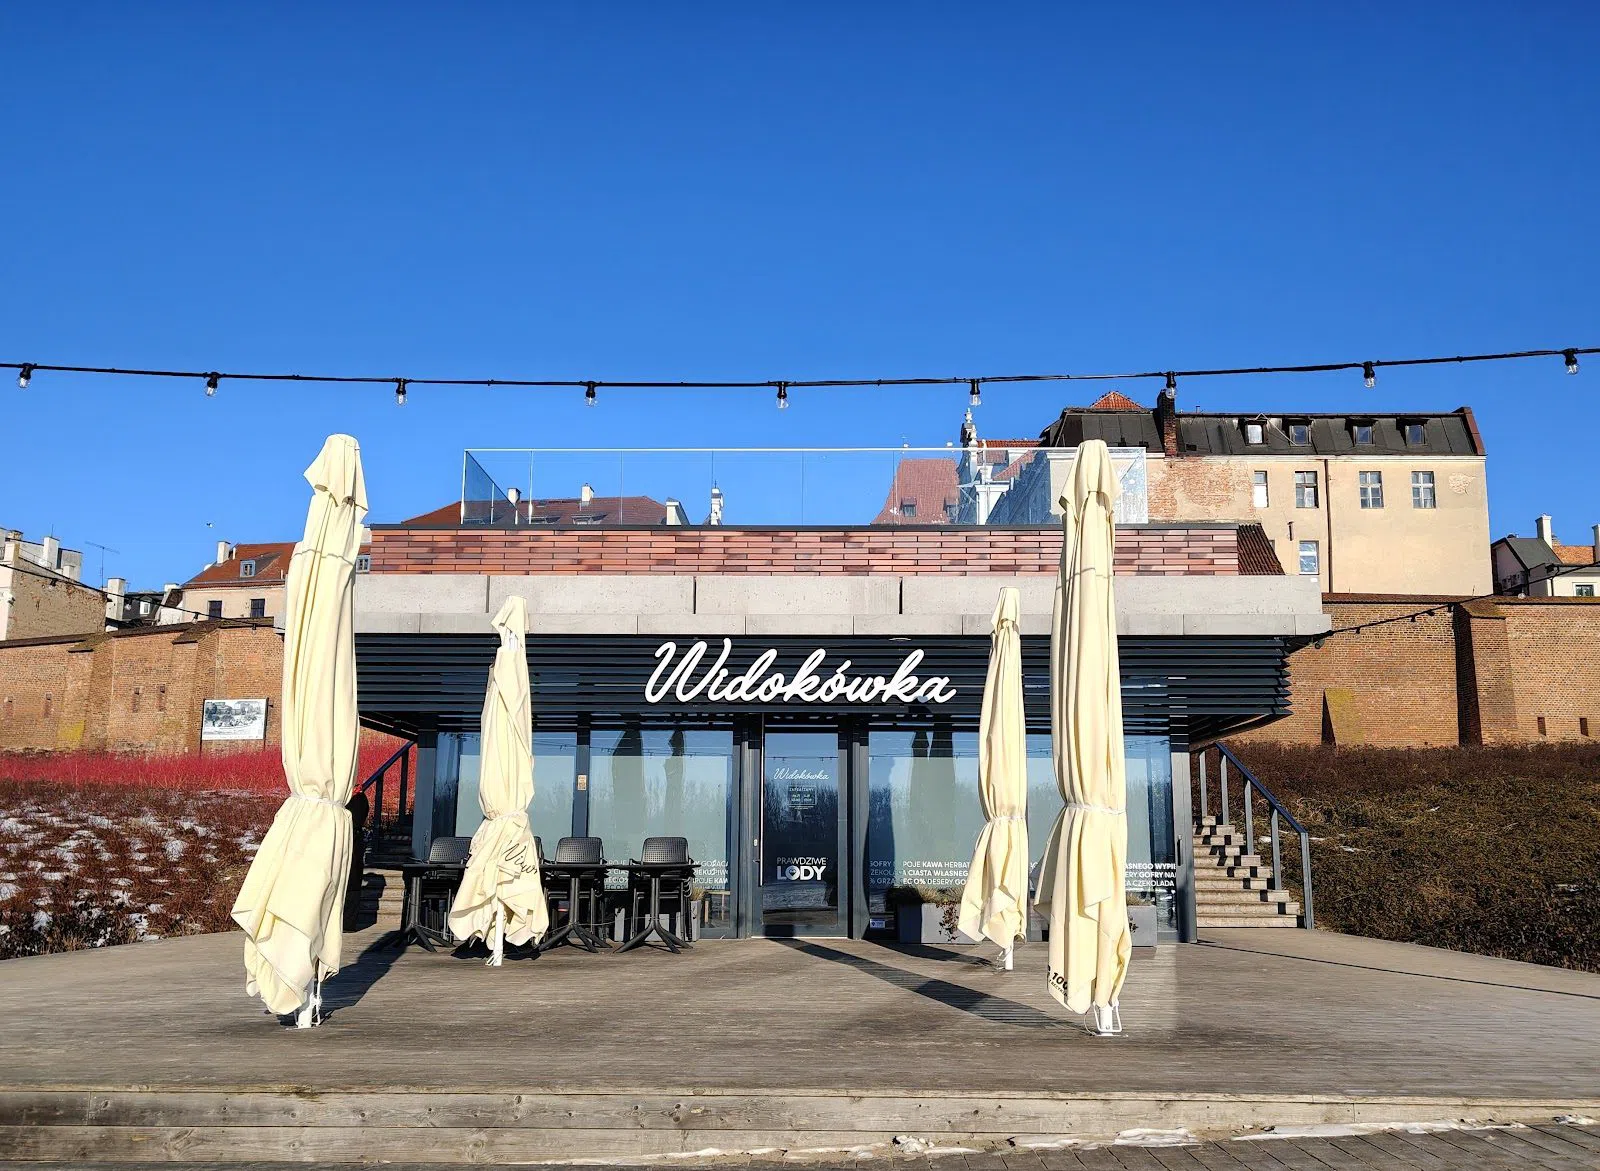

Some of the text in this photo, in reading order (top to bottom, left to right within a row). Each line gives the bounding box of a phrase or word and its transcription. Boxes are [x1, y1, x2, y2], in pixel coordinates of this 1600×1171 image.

[645, 638, 957, 703] Widokówka
[774, 767, 830, 780] Widokówka
[776, 857, 827, 866] PRAWDZIWE
[944, 861, 970, 869] HERBAT
[1125, 862, 1154, 870] ASNEGO
[776, 865, 827, 881] LODY
[908, 869, 933, 877] CIASTA
[933, 869, 969, 877] WŁASNEG
